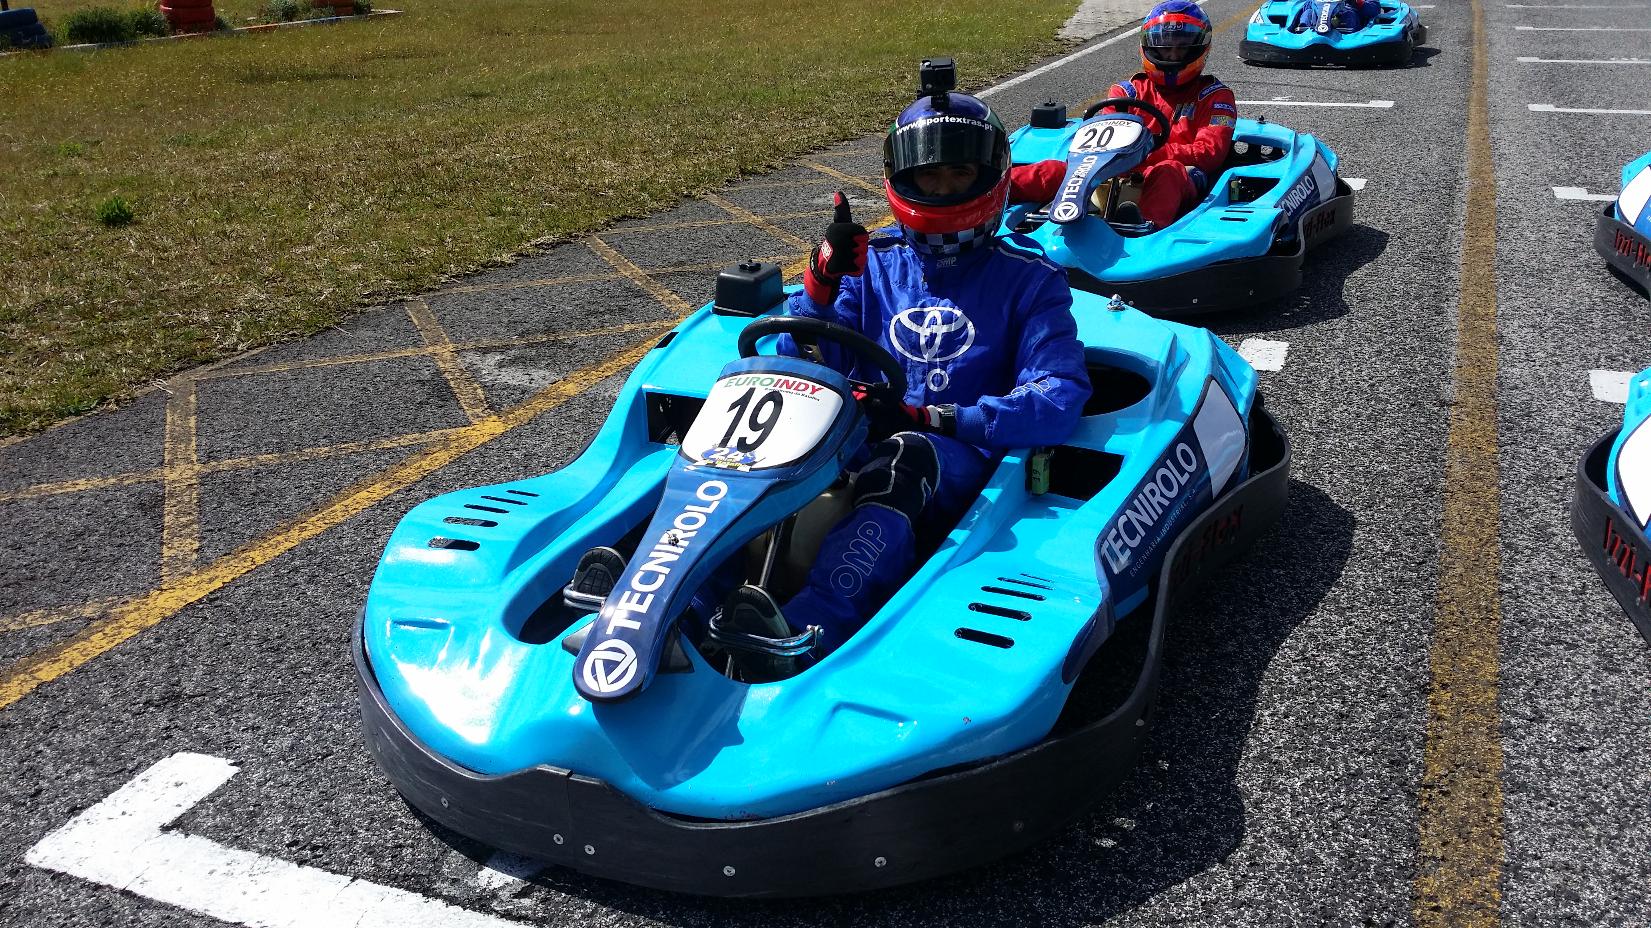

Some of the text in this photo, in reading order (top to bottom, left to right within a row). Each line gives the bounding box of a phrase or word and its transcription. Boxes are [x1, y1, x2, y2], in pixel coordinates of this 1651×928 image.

[896, 114, 993, 135] www.sportextras.pt
[1077, 126, 1115, 150] 20
[724, 376, 825, 396] EUROINDY
[717, 387, 784, 454] 19
[1100, 442, 1197, 575] TECNIROLO
[606, 480, 728, 635] TECNIROLO
[830, 521, 882, 598] OMP
